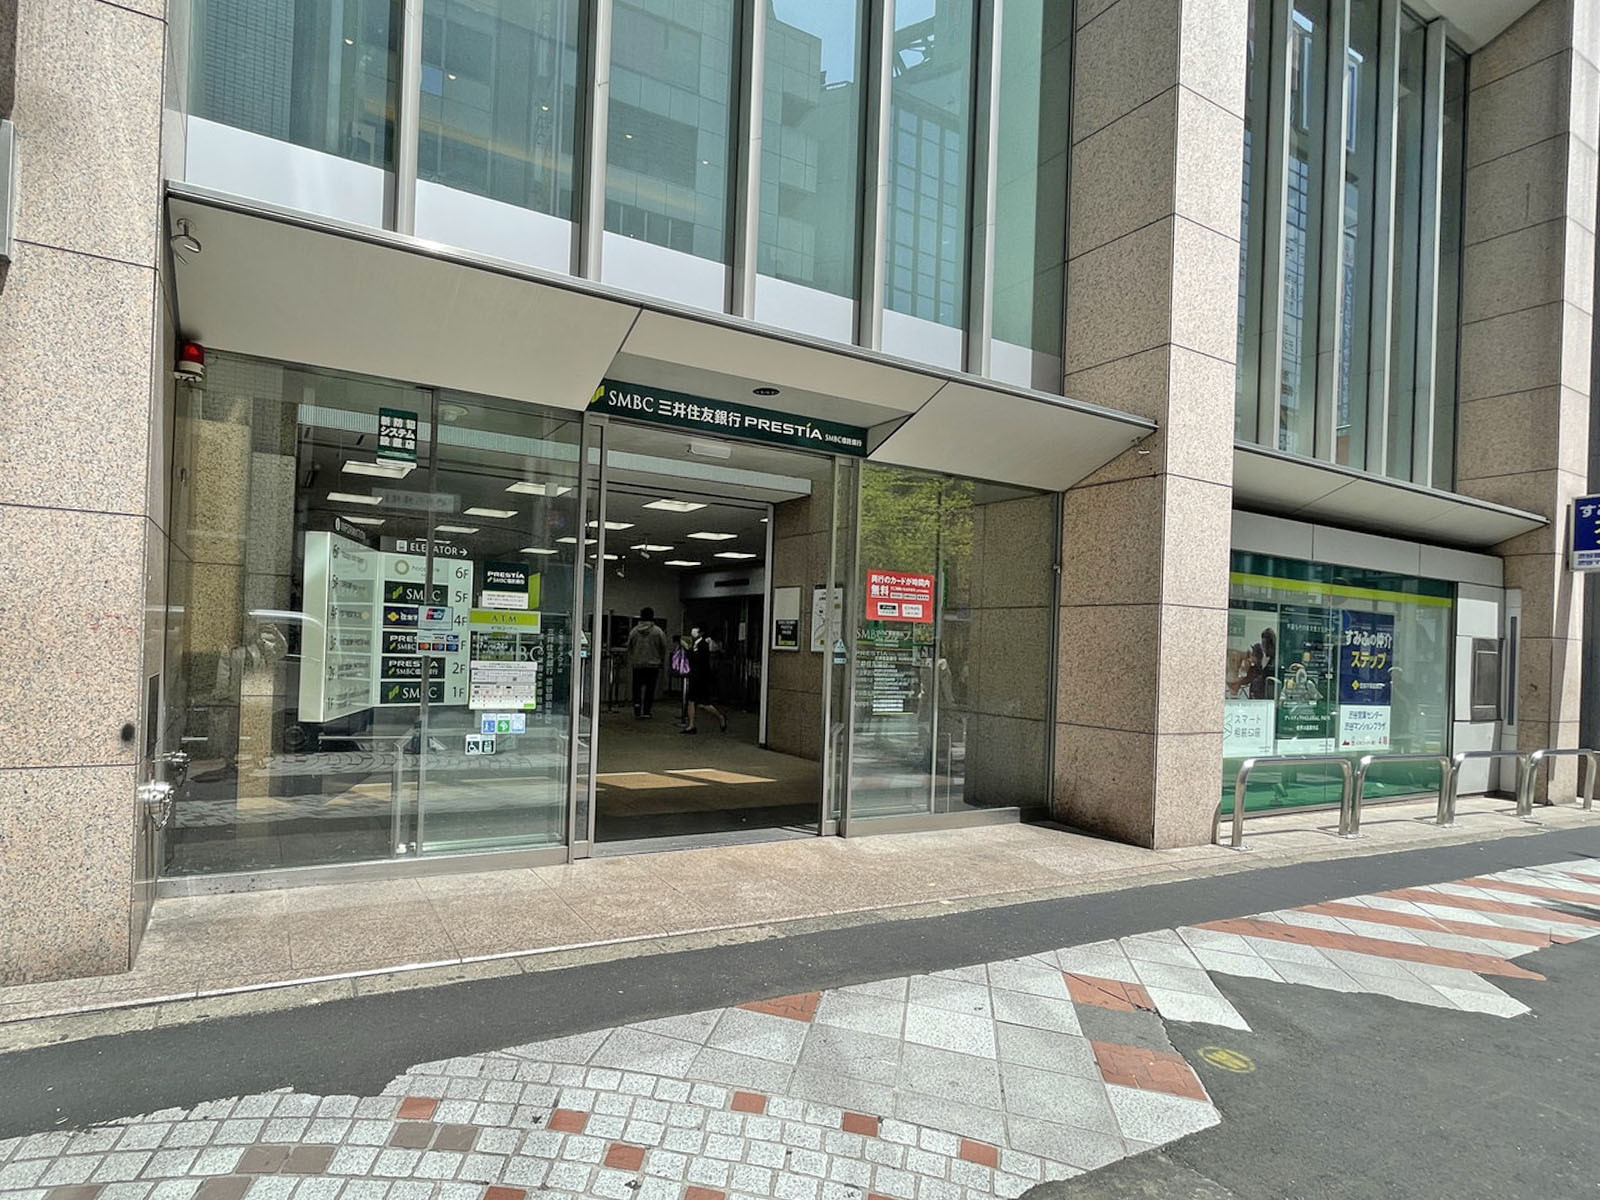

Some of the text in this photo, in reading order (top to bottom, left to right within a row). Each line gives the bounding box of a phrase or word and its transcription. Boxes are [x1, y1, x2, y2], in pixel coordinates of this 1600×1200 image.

[608, 389, 654, 412] SMBC
[658, 399, 741, 428] 三井住友銀行
[380, 426, 416, 440] システム
[1579, 504, 1600, 519] す
[410, 543, 458, 556] ELEATOR
[455, 567, 469, 580] 6F
[406, 588, 441, 602] SMC
[455, 590, 468, 603] 5F
[454, 615, 468, 626] 4F
[388, 660, 438, 668] PRESA
[1351, 651, 1387, 669] ステップ
[452, 662, 466, 674] 2F
[402, 686, 438, 699] SMC
[453, 686, 465, 698] 1F
[1234, 714, 1262, 725] スマート
